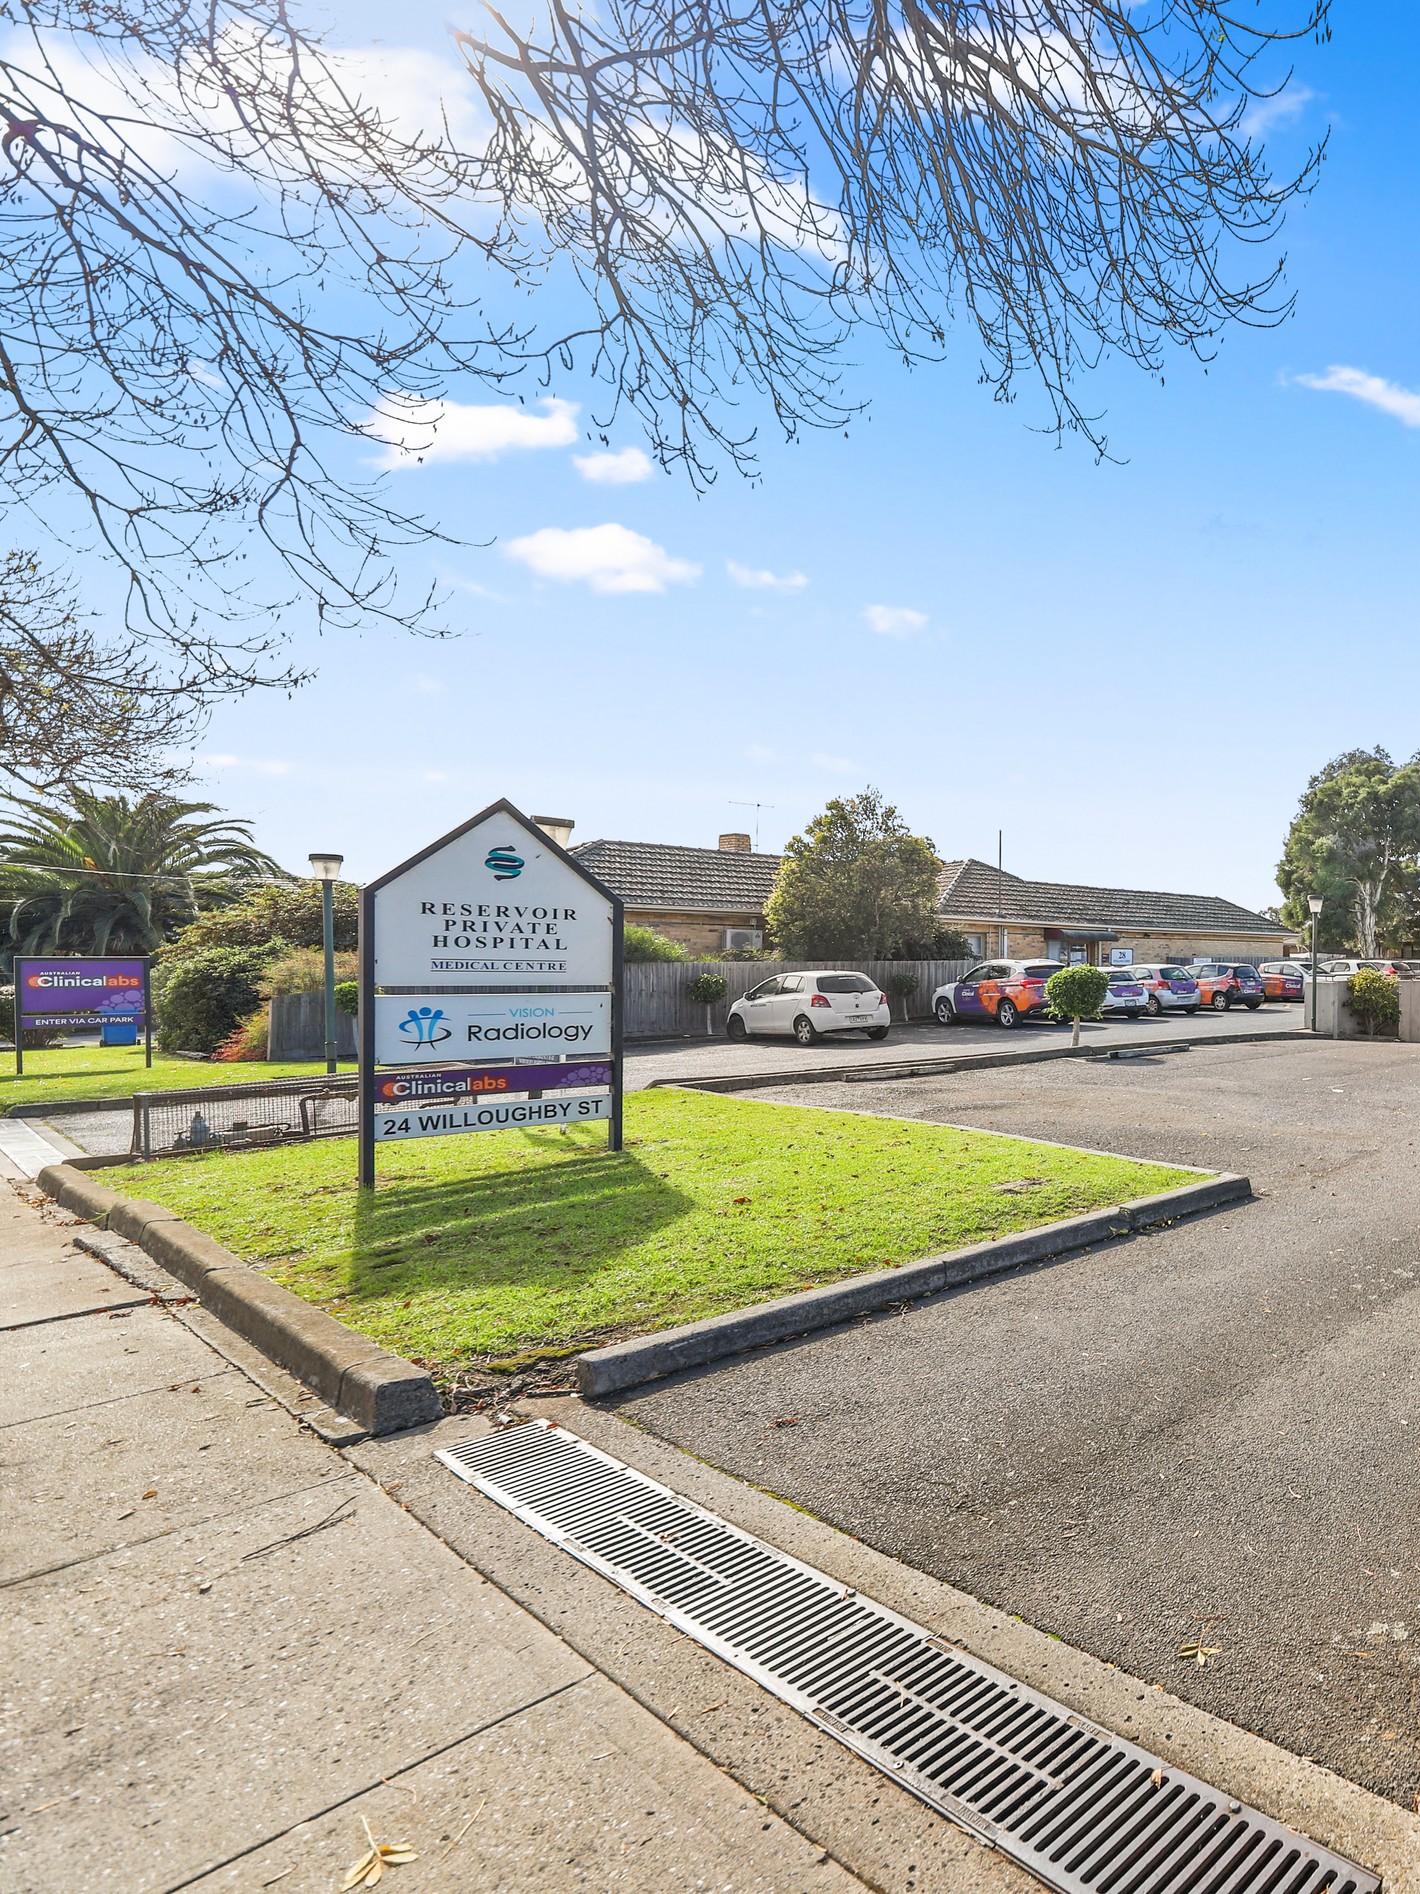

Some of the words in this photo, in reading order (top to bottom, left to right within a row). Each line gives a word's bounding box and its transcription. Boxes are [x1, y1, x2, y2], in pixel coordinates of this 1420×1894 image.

[420, 901, 578, 921] RESERVOIR
[443, 919, 558, 935] PRIVATE
[432, 935, 568, 951] HOSPITAL
[430, 961, 500, 971] MEDICAL
[502, 962, 568, 971] CENTRE
[508, 1007, 555, 1018] VISION
[35, 1018, 67, 1026] ENTER
[69, 1017, 86, 1025] VIA
[467, 1022, 593, 1042] Radiology
[383, 1118, 411, 1136] 24
[418, 1102, 572, 1132] WILLOUGHBY
[577, 1100, 603, 1115] ST
